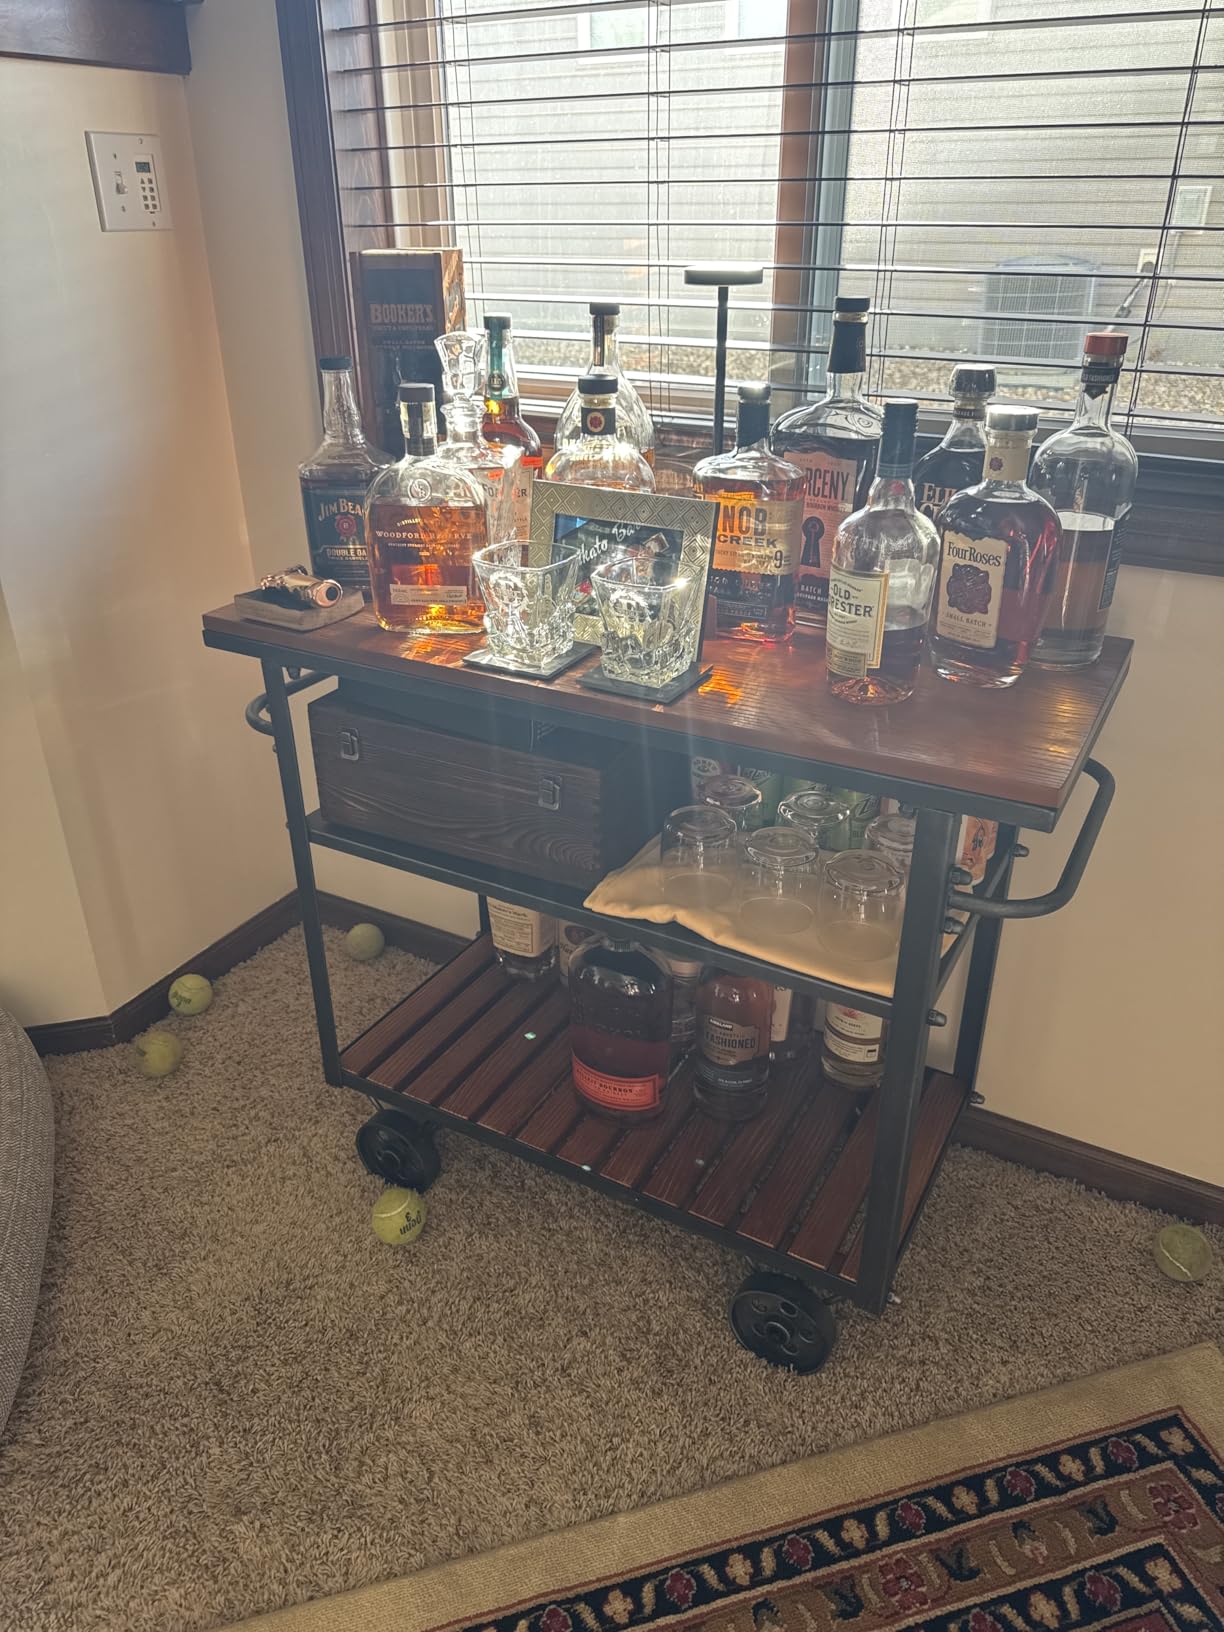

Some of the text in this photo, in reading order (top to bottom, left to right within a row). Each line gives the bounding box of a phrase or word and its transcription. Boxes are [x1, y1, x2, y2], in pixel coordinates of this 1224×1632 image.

[370, 303, 433, 323] BOOKER'S
[806, 467, 849, 501] RCENY
[923, 483, 956, 504] ELI
[319, 503, 337, 521] JIM
[722, 505, 768, 537] NOB
[375, 530, 426, 539] WOODFORD
[717, 533, 778, 548] CREEK
[326, 548, 368, 557] DOUBLE OA
[774, 550, 783, 568] 9
[833, 583, 851, 600] OLD
[830, 596, 873, 618] RESTER
[706, 1031, 756, 1049] FASHIONED
